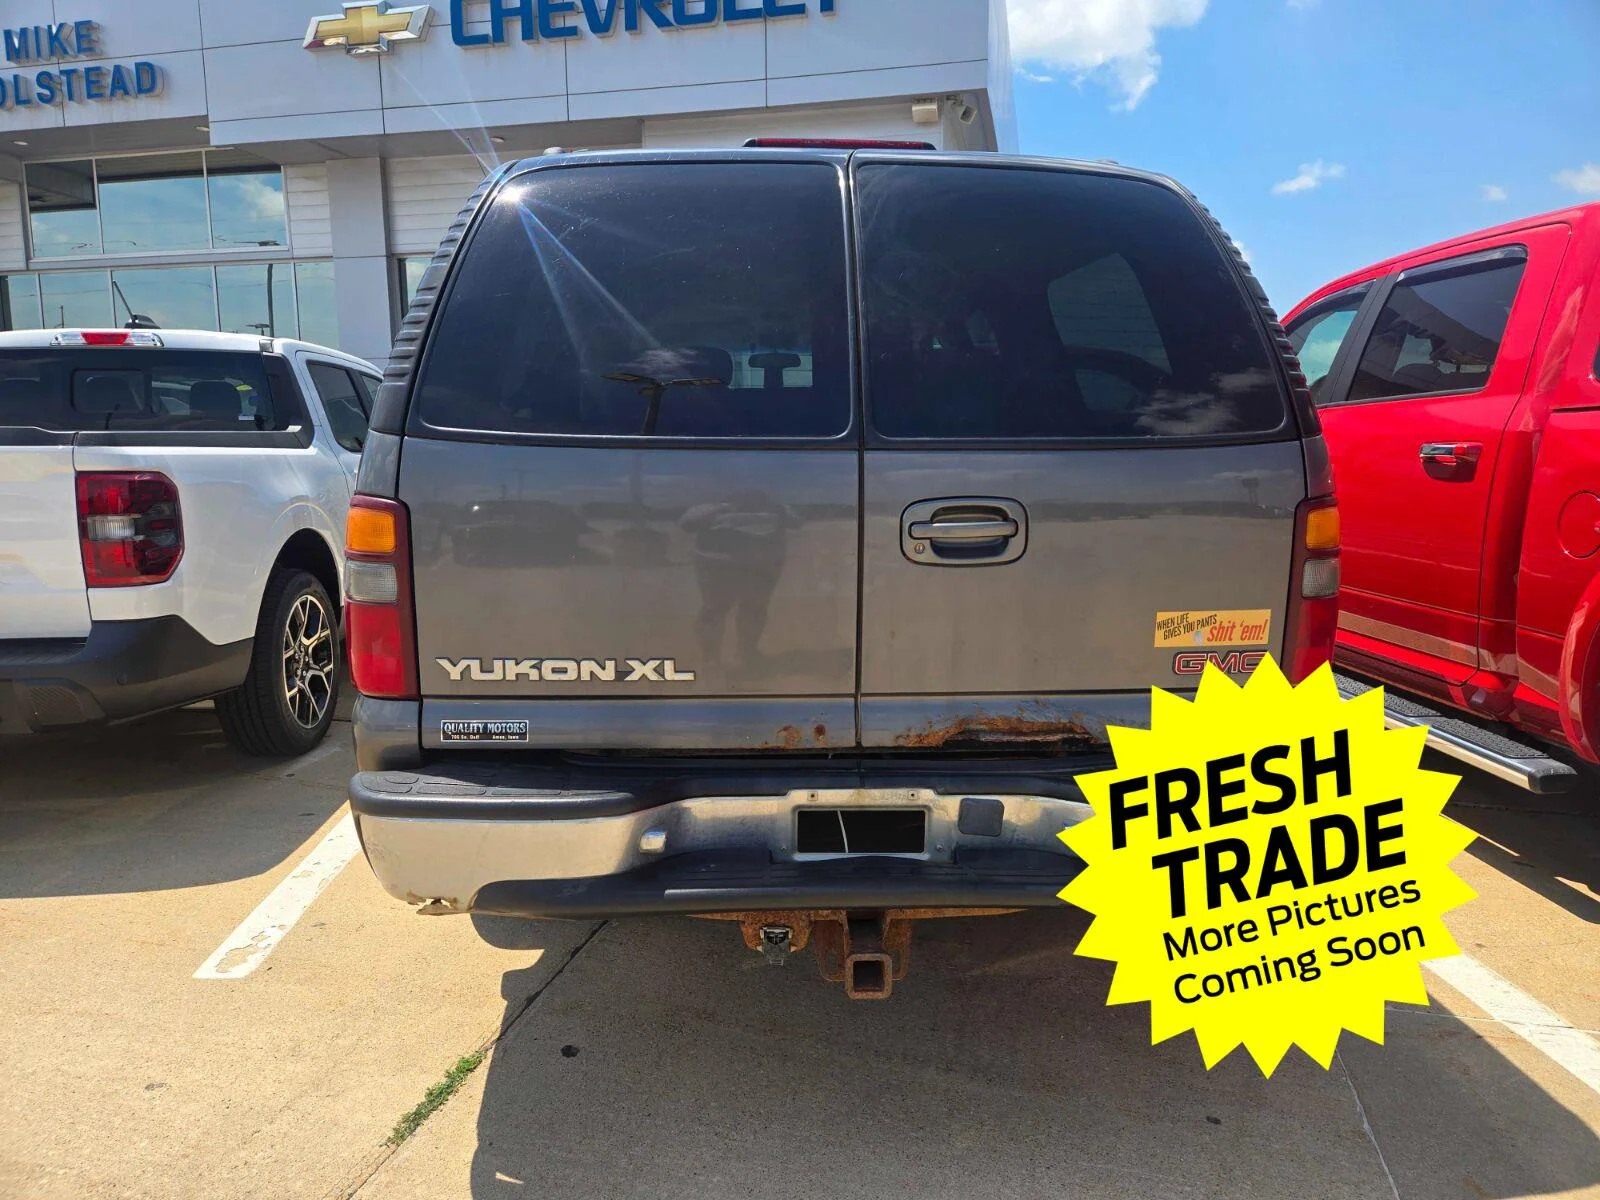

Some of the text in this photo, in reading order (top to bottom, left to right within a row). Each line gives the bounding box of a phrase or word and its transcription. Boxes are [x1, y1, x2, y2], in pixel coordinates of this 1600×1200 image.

[450, 0, 833, 46] CHEVR
[3, 20, 97, 61] MIKE
[1156, 613, 1190, 631] WHEN LIFE
[1163, 614, 1217, 640] GIVES YOU PANTS
[1207, 620, 1236, 642] shit
[435, 657, 695, 682] YUKON XL
[1173, 651, 1268, 675] GMC
[444, 723, 526, 735] QUALITY MOTORS
